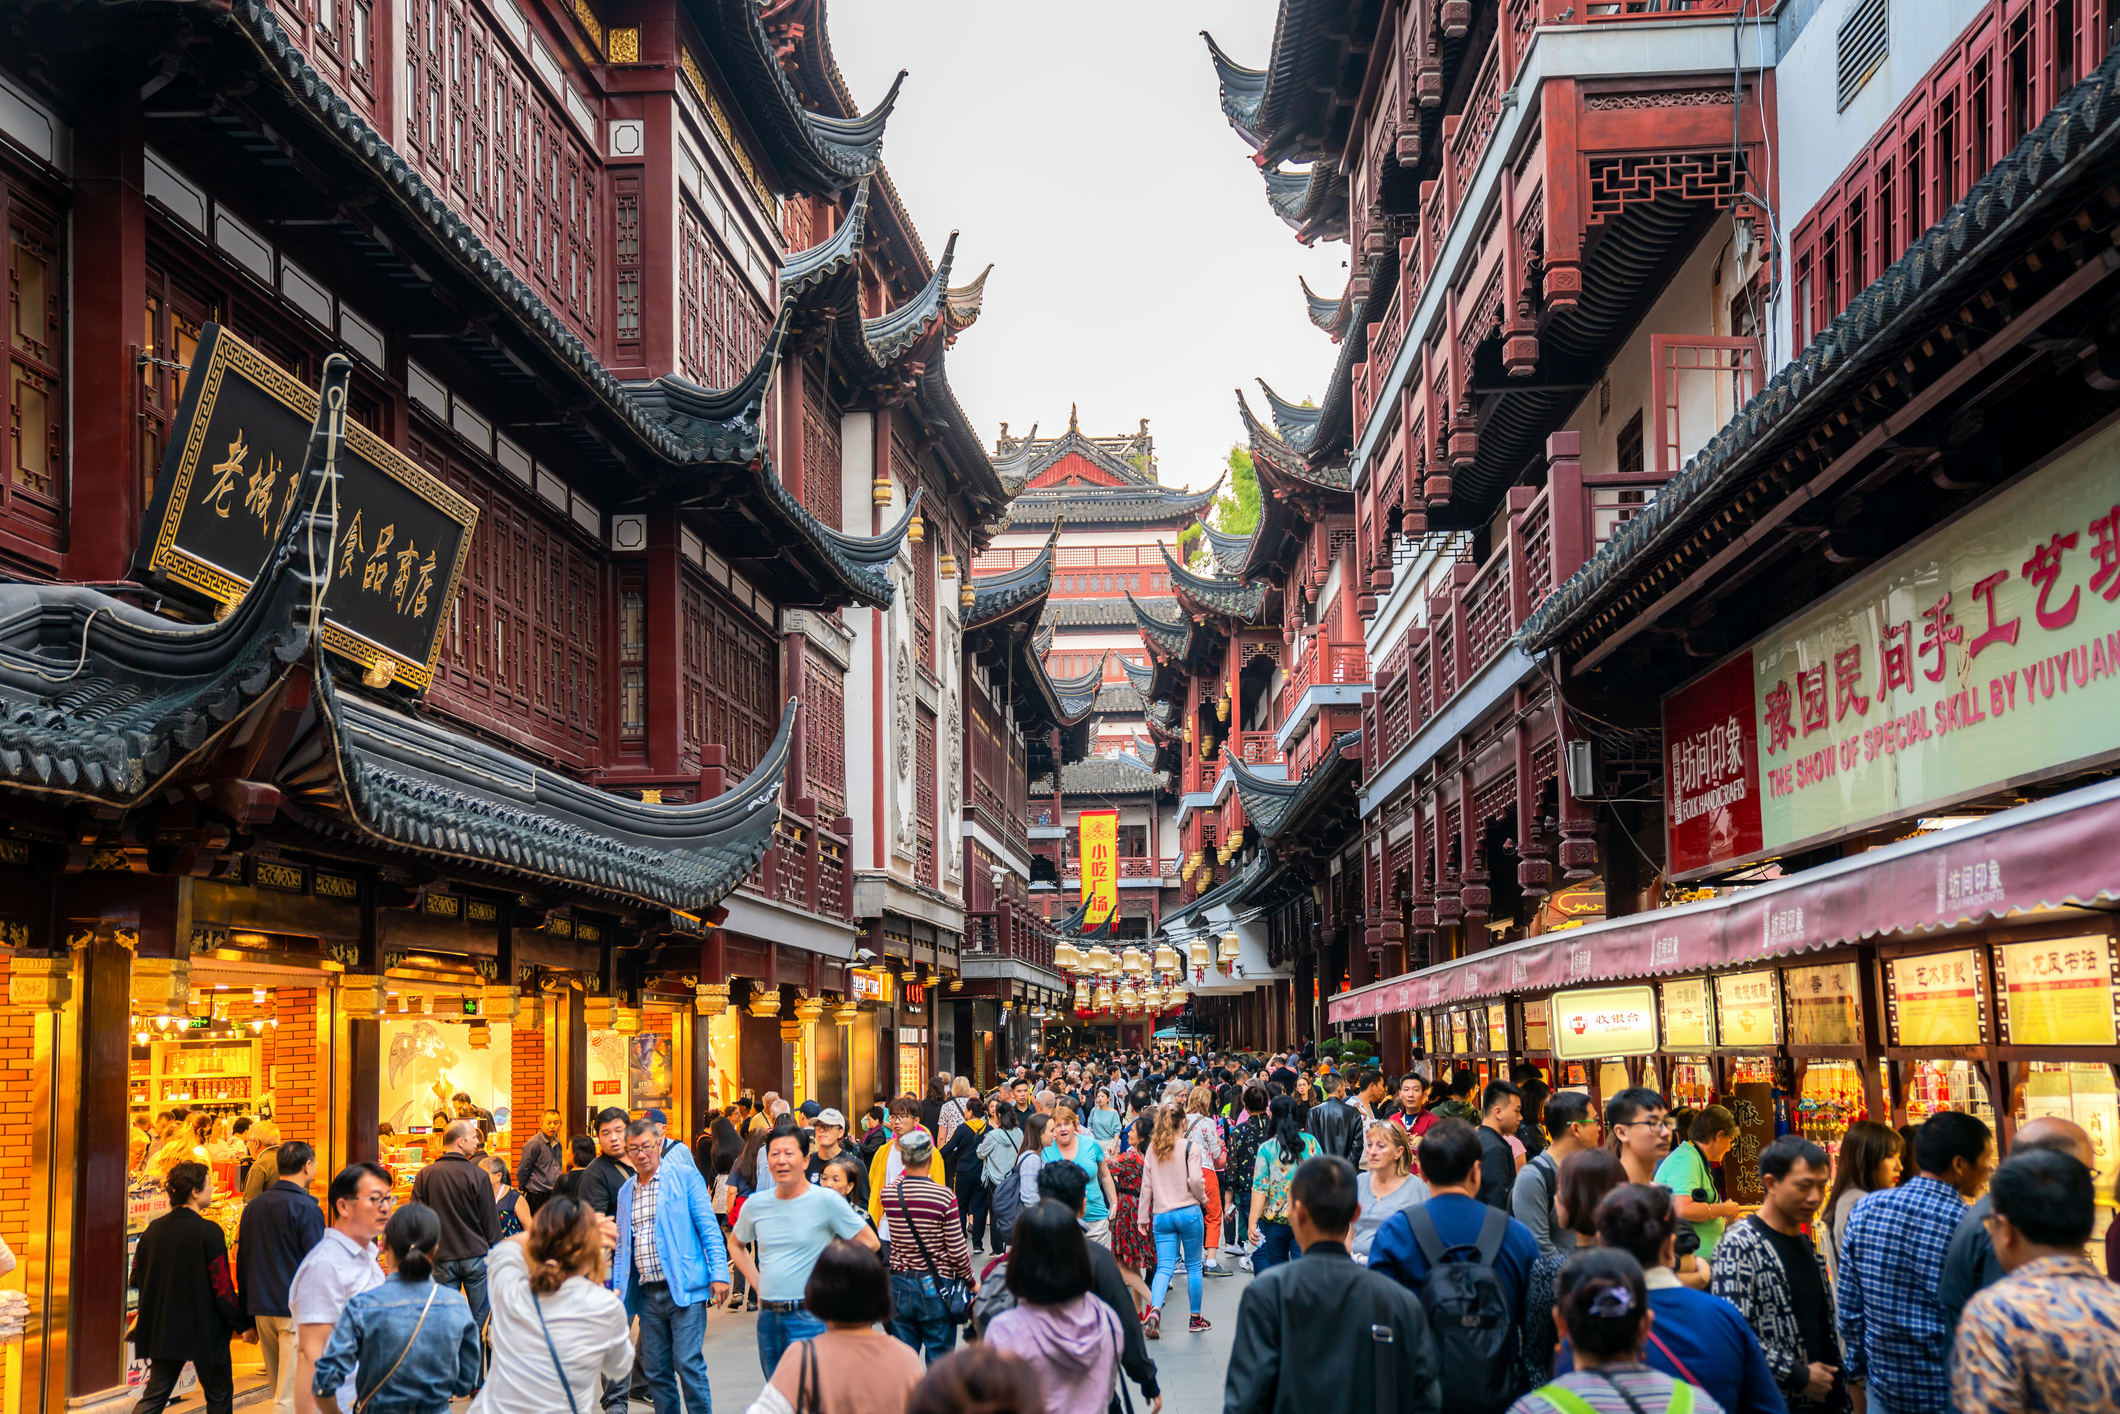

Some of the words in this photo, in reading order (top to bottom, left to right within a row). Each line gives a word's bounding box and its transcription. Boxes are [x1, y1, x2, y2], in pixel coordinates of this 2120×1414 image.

[202, 427, 438, 619] 老城食品商店
[1767, 759, 1794, 798] THE
[1796, 745, 1836, 789] SHOW
[1839, 735, 1860, 771] OF
[1863, 706, 1932, 762] SPECIAL
[1934, 686, 1986, 736] SKILL
[1989, 670, 2018, 717] BY
[2022, 628, 2120, 703] YUYUAN
[1681, 715, 1744, 793] 坊间印象
[1683, 796, 1700, 822] FOLK
[1699, 778, 1746, 815] HANDICRAFTS
[1091, 843, 1109, 912] 小吃广场
[1948, 858, 2003, 900] 坊间印象
[2032, 948, 2098, 977] 龙凤书法
[1596, 1012, 1639, 1025] 收银台
[1605, 1025, 1631, 1033] Cashier
